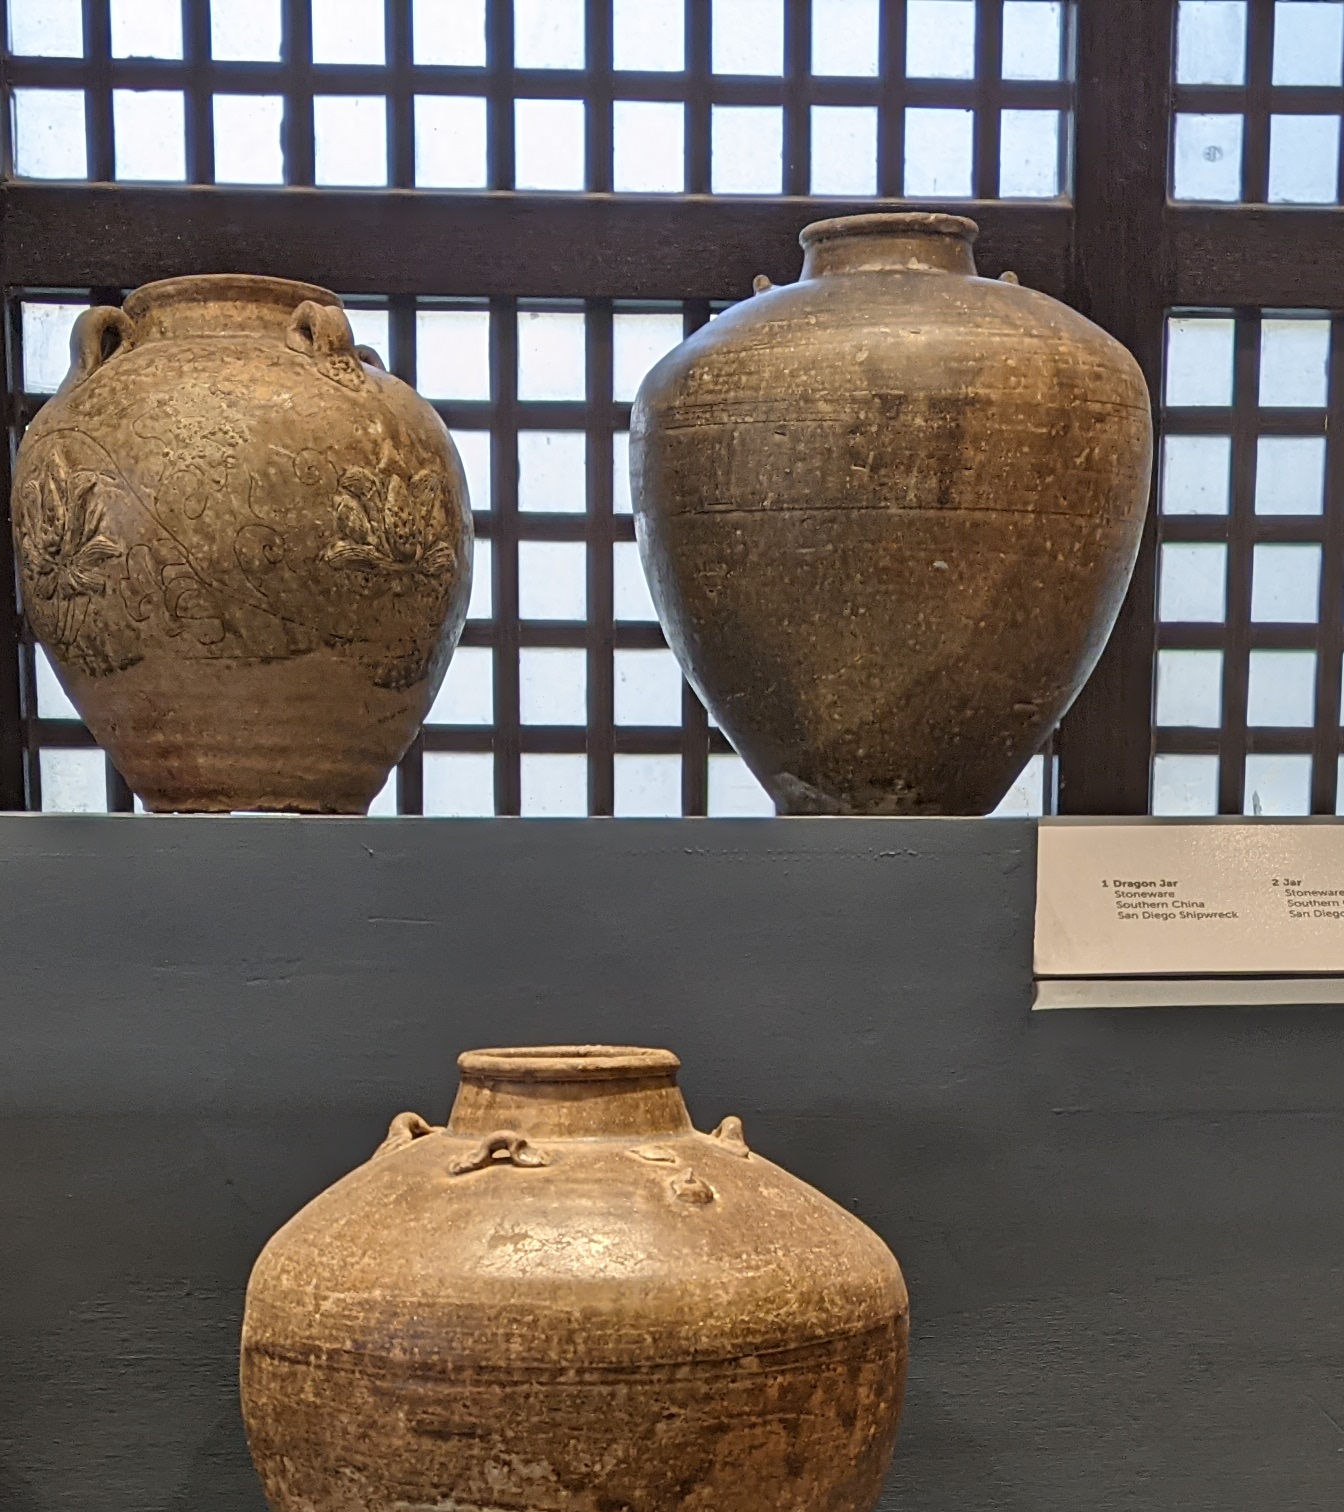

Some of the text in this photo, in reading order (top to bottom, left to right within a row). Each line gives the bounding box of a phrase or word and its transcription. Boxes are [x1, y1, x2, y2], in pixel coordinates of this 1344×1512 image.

[1101, 879, 1178, 889] 1 Dragon Jar
[1271, 878, 1302, 887] 2 Jar
[1114, 890, 1175, 898] Stoneware
[1116, 900, 1205, 909] Southern China
[1287, 899, 1340, 907] Southern
[1118, 911, 1239, 921] San Diego Shipwreck
[1289, 909, 1310, 918] San
